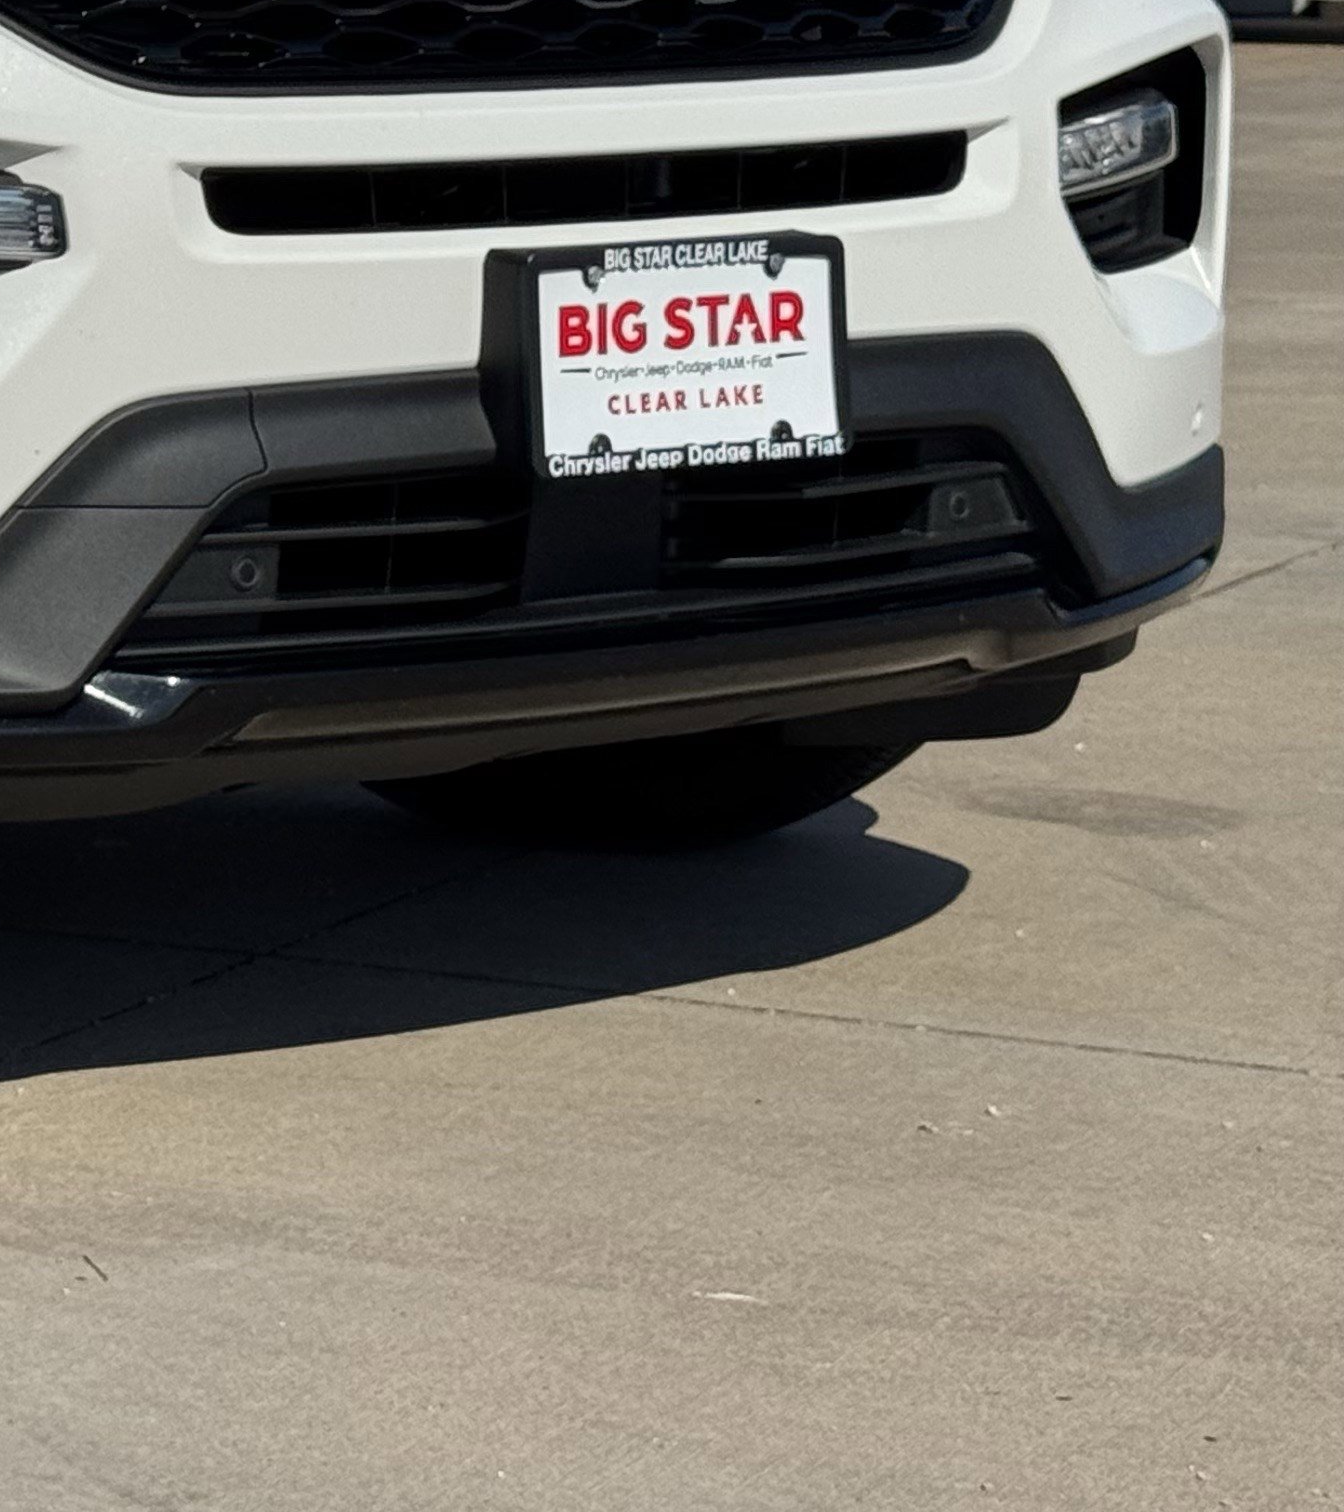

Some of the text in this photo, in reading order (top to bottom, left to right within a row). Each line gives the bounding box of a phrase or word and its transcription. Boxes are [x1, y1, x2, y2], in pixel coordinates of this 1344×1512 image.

[604, 239, 769, 269] BIG STAR CLEAR LAKE
[559, 292, 805, 358] BIG STAR
[608, 384, 764, 415] CLEAR LAKE
[548, 431, 846, 478] Chrysler Jeep Dodge Ram Fiat
